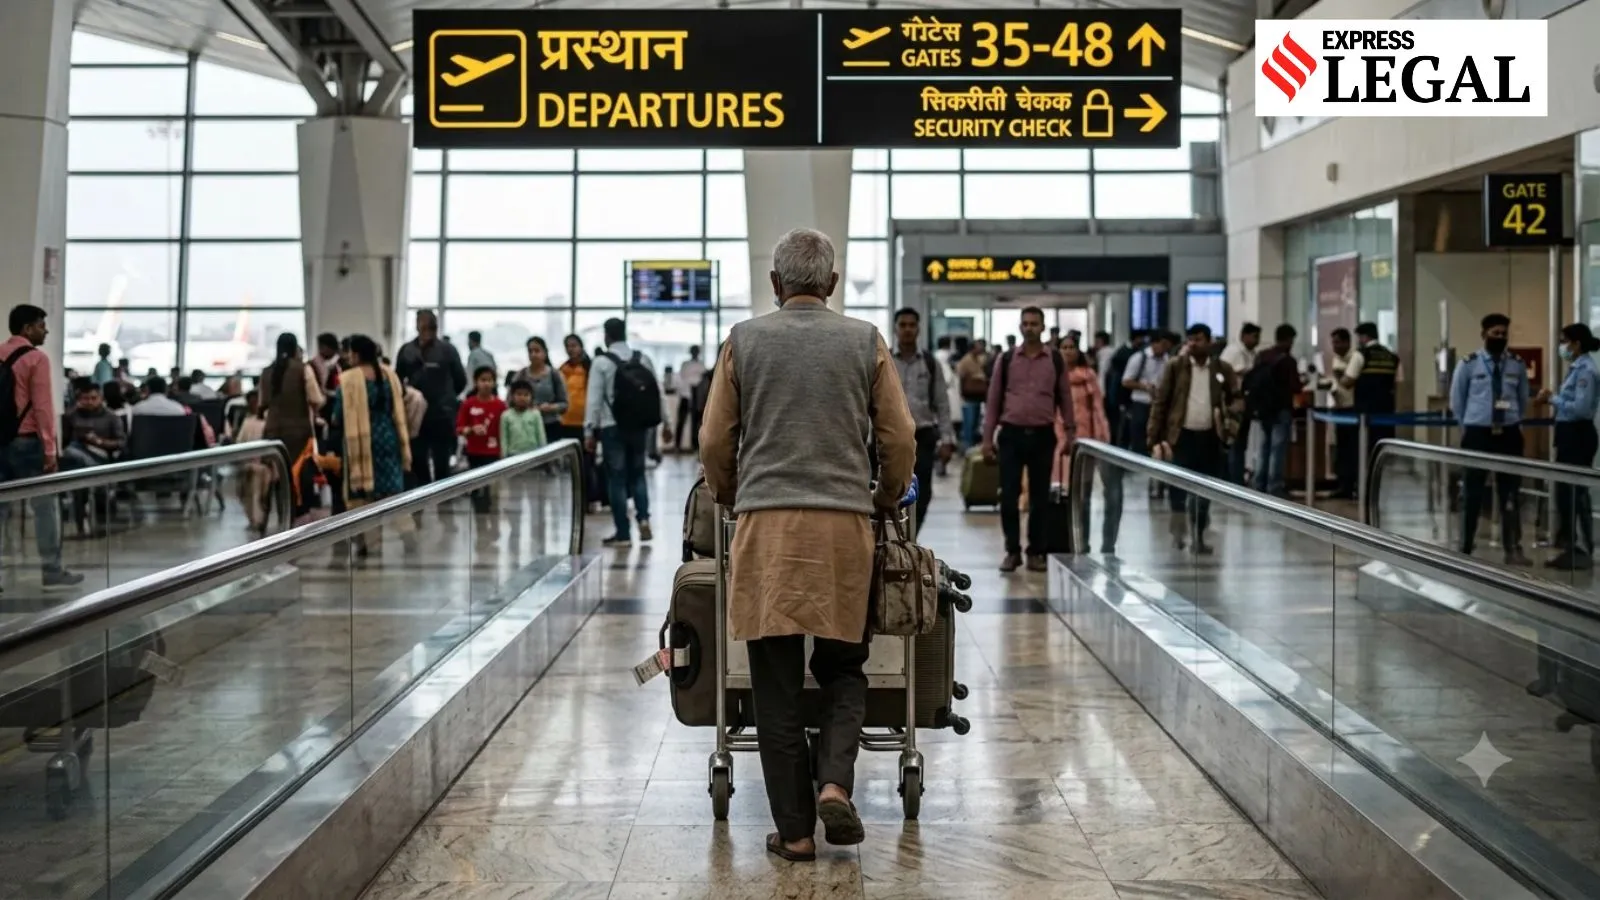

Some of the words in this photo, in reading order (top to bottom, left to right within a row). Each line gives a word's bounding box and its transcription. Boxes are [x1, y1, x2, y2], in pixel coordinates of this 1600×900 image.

[537, 30, 688, 71] प्रस्थान
[901, 48, 962, 68] GATES
[970, 22, 1113, 68] 35-48
[537, 92, 785, 129] DEPARTURES
[914, 118, 1004, 138] SECURITY
[1008, 118, 1073, 138] CHECK
[1502, 183, 1547, 199] GATE
[1502, 203, 1547, 236] 42
[1010, 259, 1036, 280] 42
